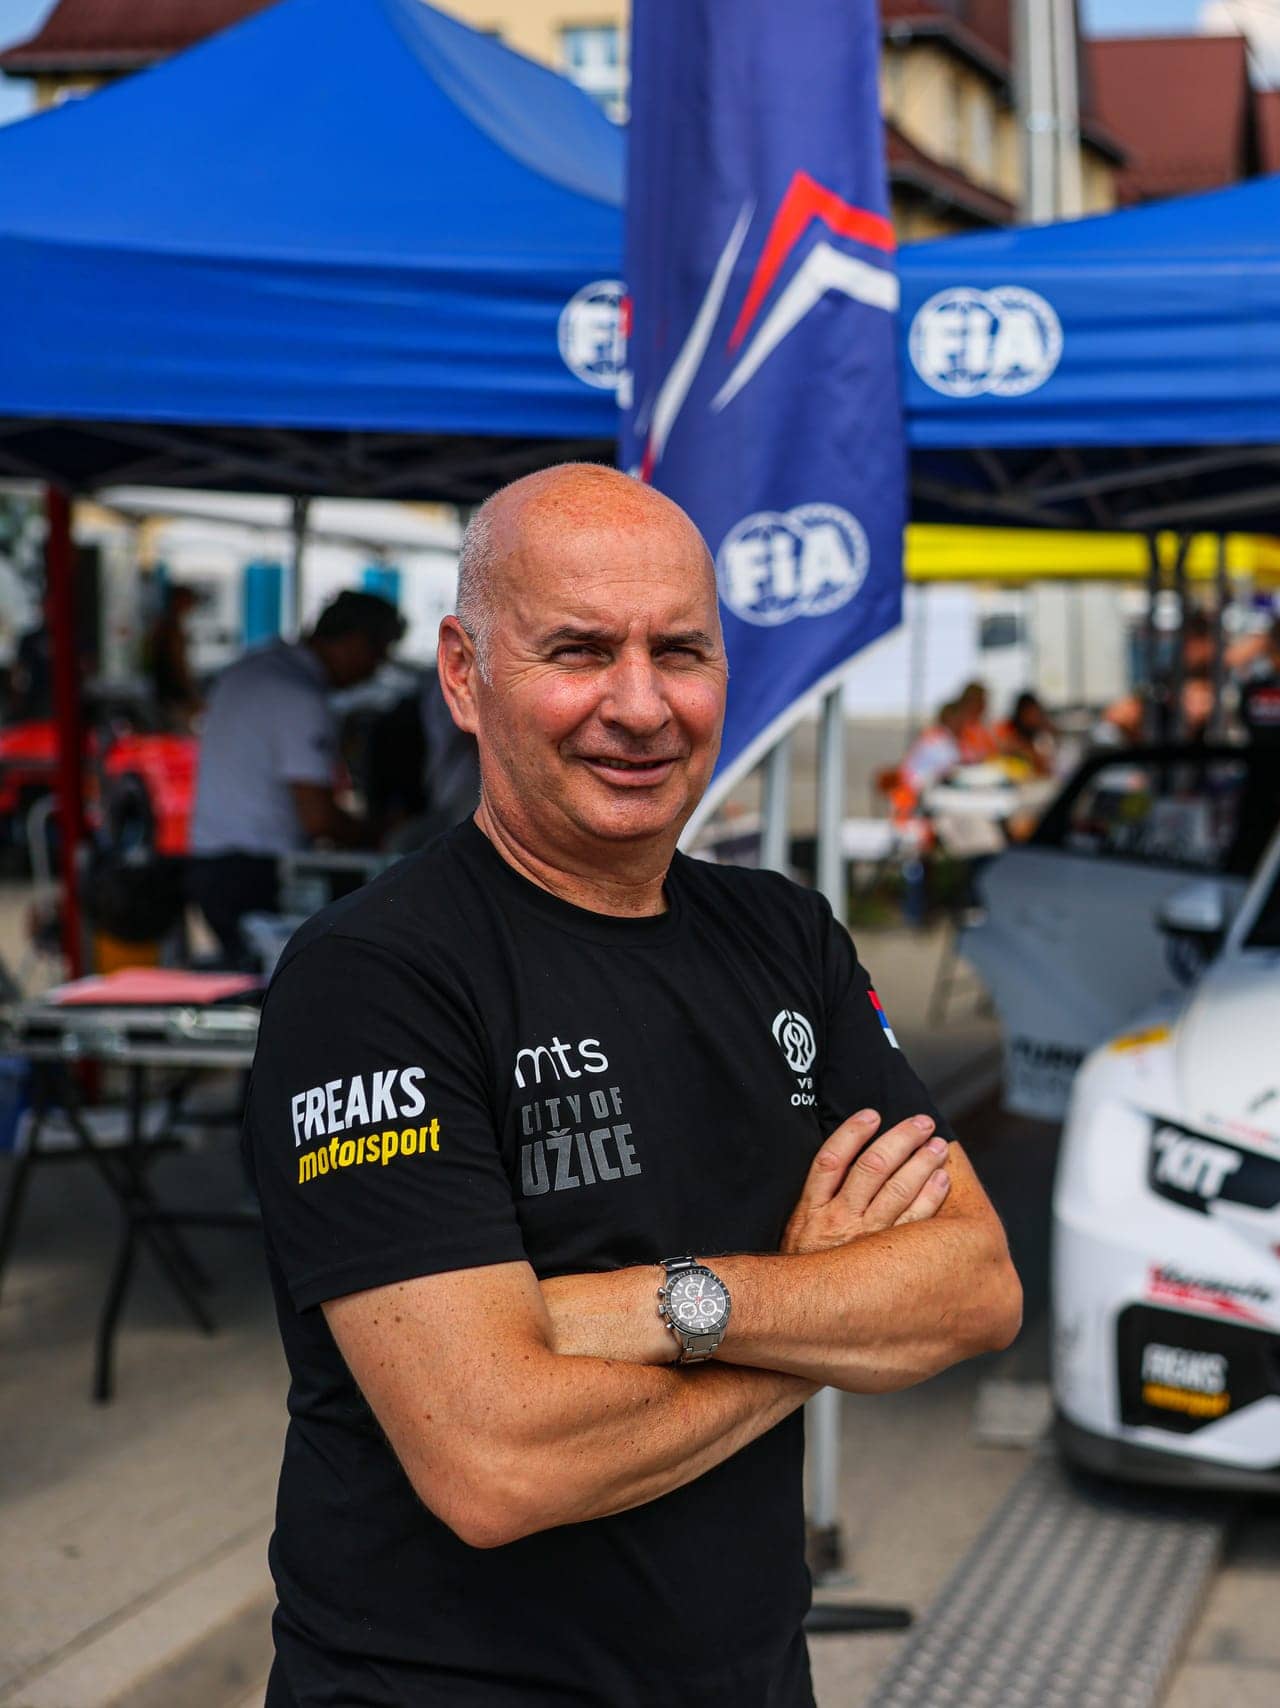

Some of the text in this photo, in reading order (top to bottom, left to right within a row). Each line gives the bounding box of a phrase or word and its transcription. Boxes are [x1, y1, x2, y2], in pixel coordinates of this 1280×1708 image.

[918, 304, 1052, 384] FIA
[724, 523, 854, 611] FIA
[514, 1036, 610, 1089] mts
[291, 1066, 426, 1148] FREAKS
[521, 1086, 623, 1136] CITY OF
[298, 1117, 441, 1185] motorsport
[521, 1123, 642, 1197] UŽICE
